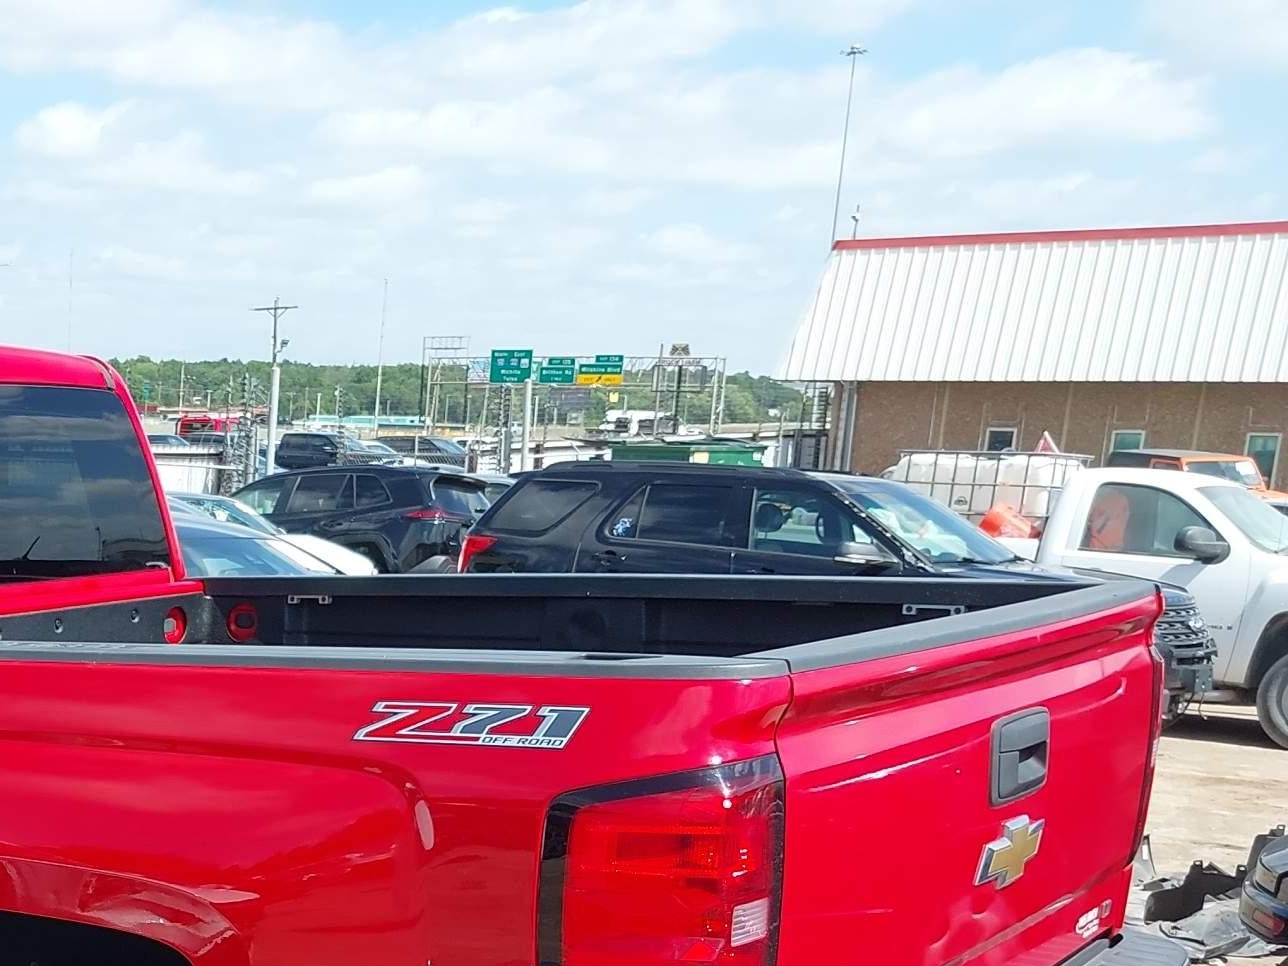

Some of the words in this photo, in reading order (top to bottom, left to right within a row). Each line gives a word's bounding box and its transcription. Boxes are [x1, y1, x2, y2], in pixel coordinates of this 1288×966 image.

[351, 701, 591, 749] Z71
[482, 736, 513, 744] OFF
[516, 737, 564, 747] ROAD
